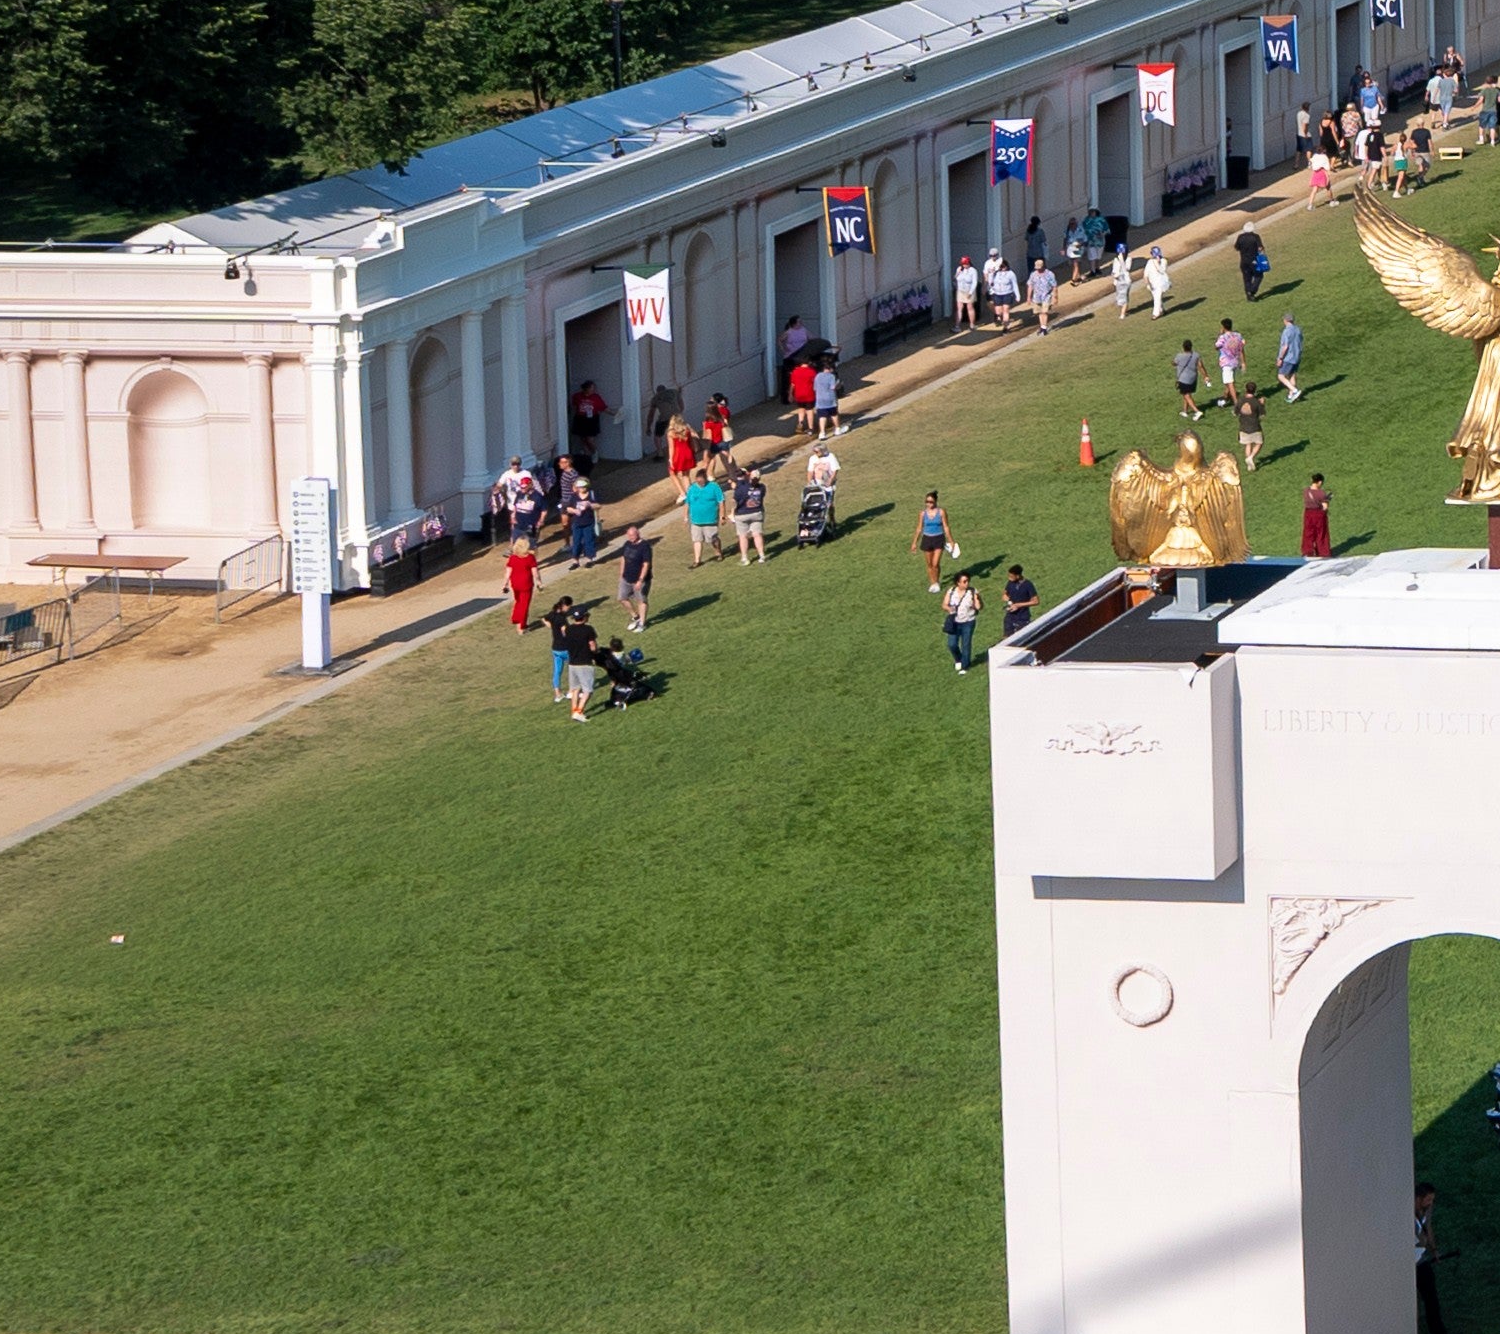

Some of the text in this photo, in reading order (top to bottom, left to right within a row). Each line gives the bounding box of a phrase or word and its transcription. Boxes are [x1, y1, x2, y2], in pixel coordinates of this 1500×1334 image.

[1267, 39, 1292, 62] VA
[1146, 90, 1168, 113] DC
[996, 147, 1028, 164] 250
[835, 216, 865, 243] NC
[628, 296, 666, 327] WV
[1262, 709, 1375, 734] LIBERTY
[1383, 711, 1404, 734] &
